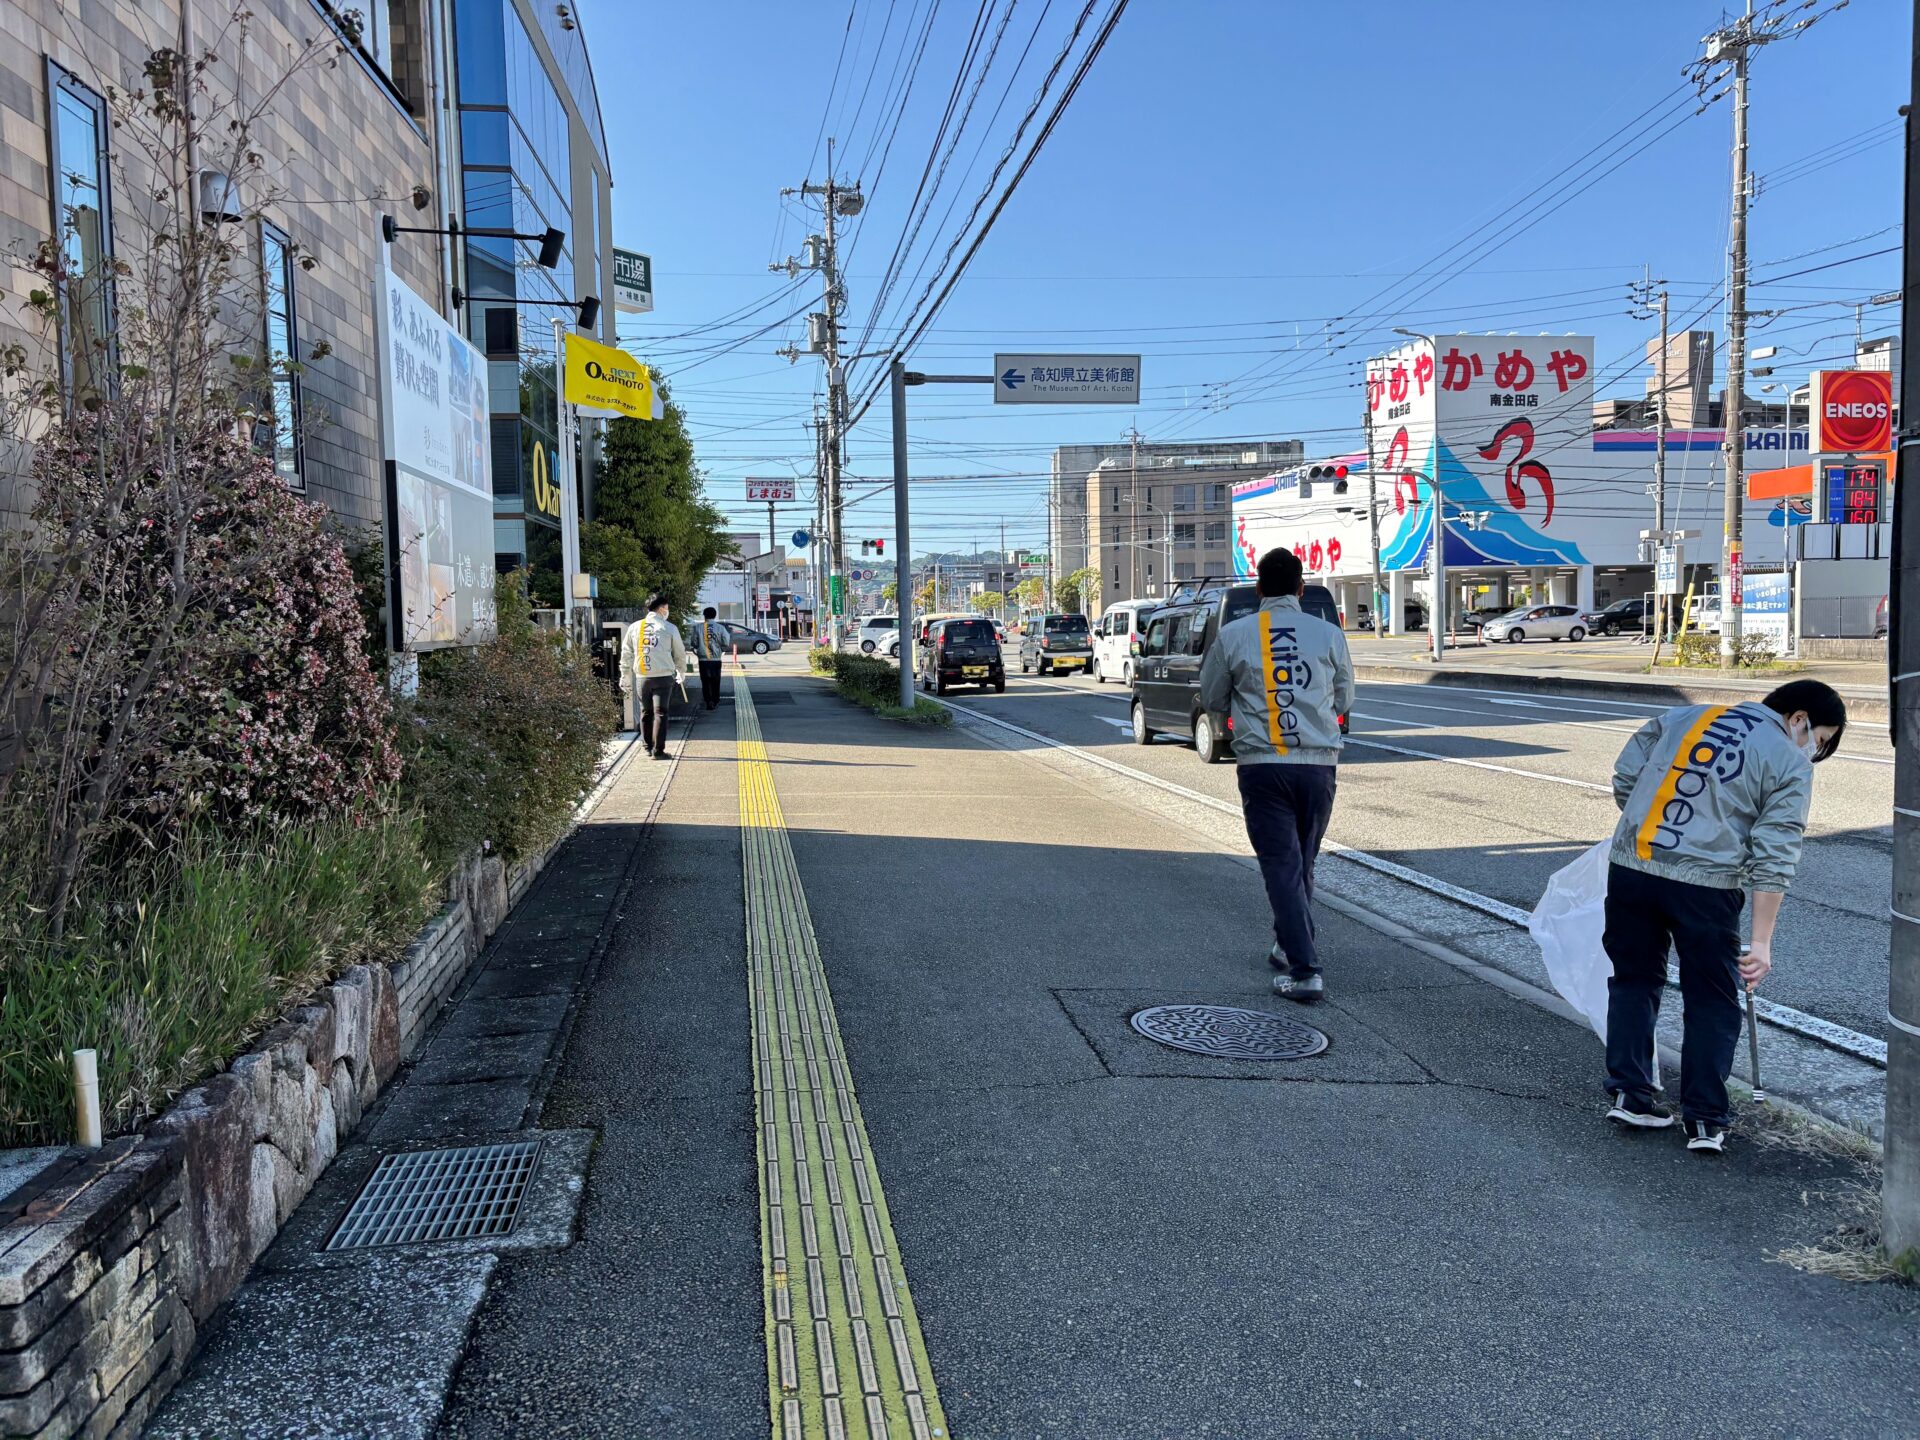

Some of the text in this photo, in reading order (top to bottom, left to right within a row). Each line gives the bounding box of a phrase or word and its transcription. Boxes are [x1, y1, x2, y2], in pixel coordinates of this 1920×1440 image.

[614, 255, 645, 281] 市場
[395, 338, 440, 408] 贅沢な空間
[1031, 367, 1135, 383] 高知県立美術館
[1441, 348, 1587, 392] かめや
[1368, 352, 1434, 411] かめや
[1490, 394, 1539, 407] 南金田店
[1388, 402, 1411, 420] 南金田店
[1826, 403, 1887, 418] ENEOS
[1850, 470, 1875, 487] 174
[749, 488, 792, 498] しまむら
[1850, 490, 1875, 508] 184
[1267, 627, 1301, 747] Kitapen
[1648, 706, 1764, 850] Kitapen
